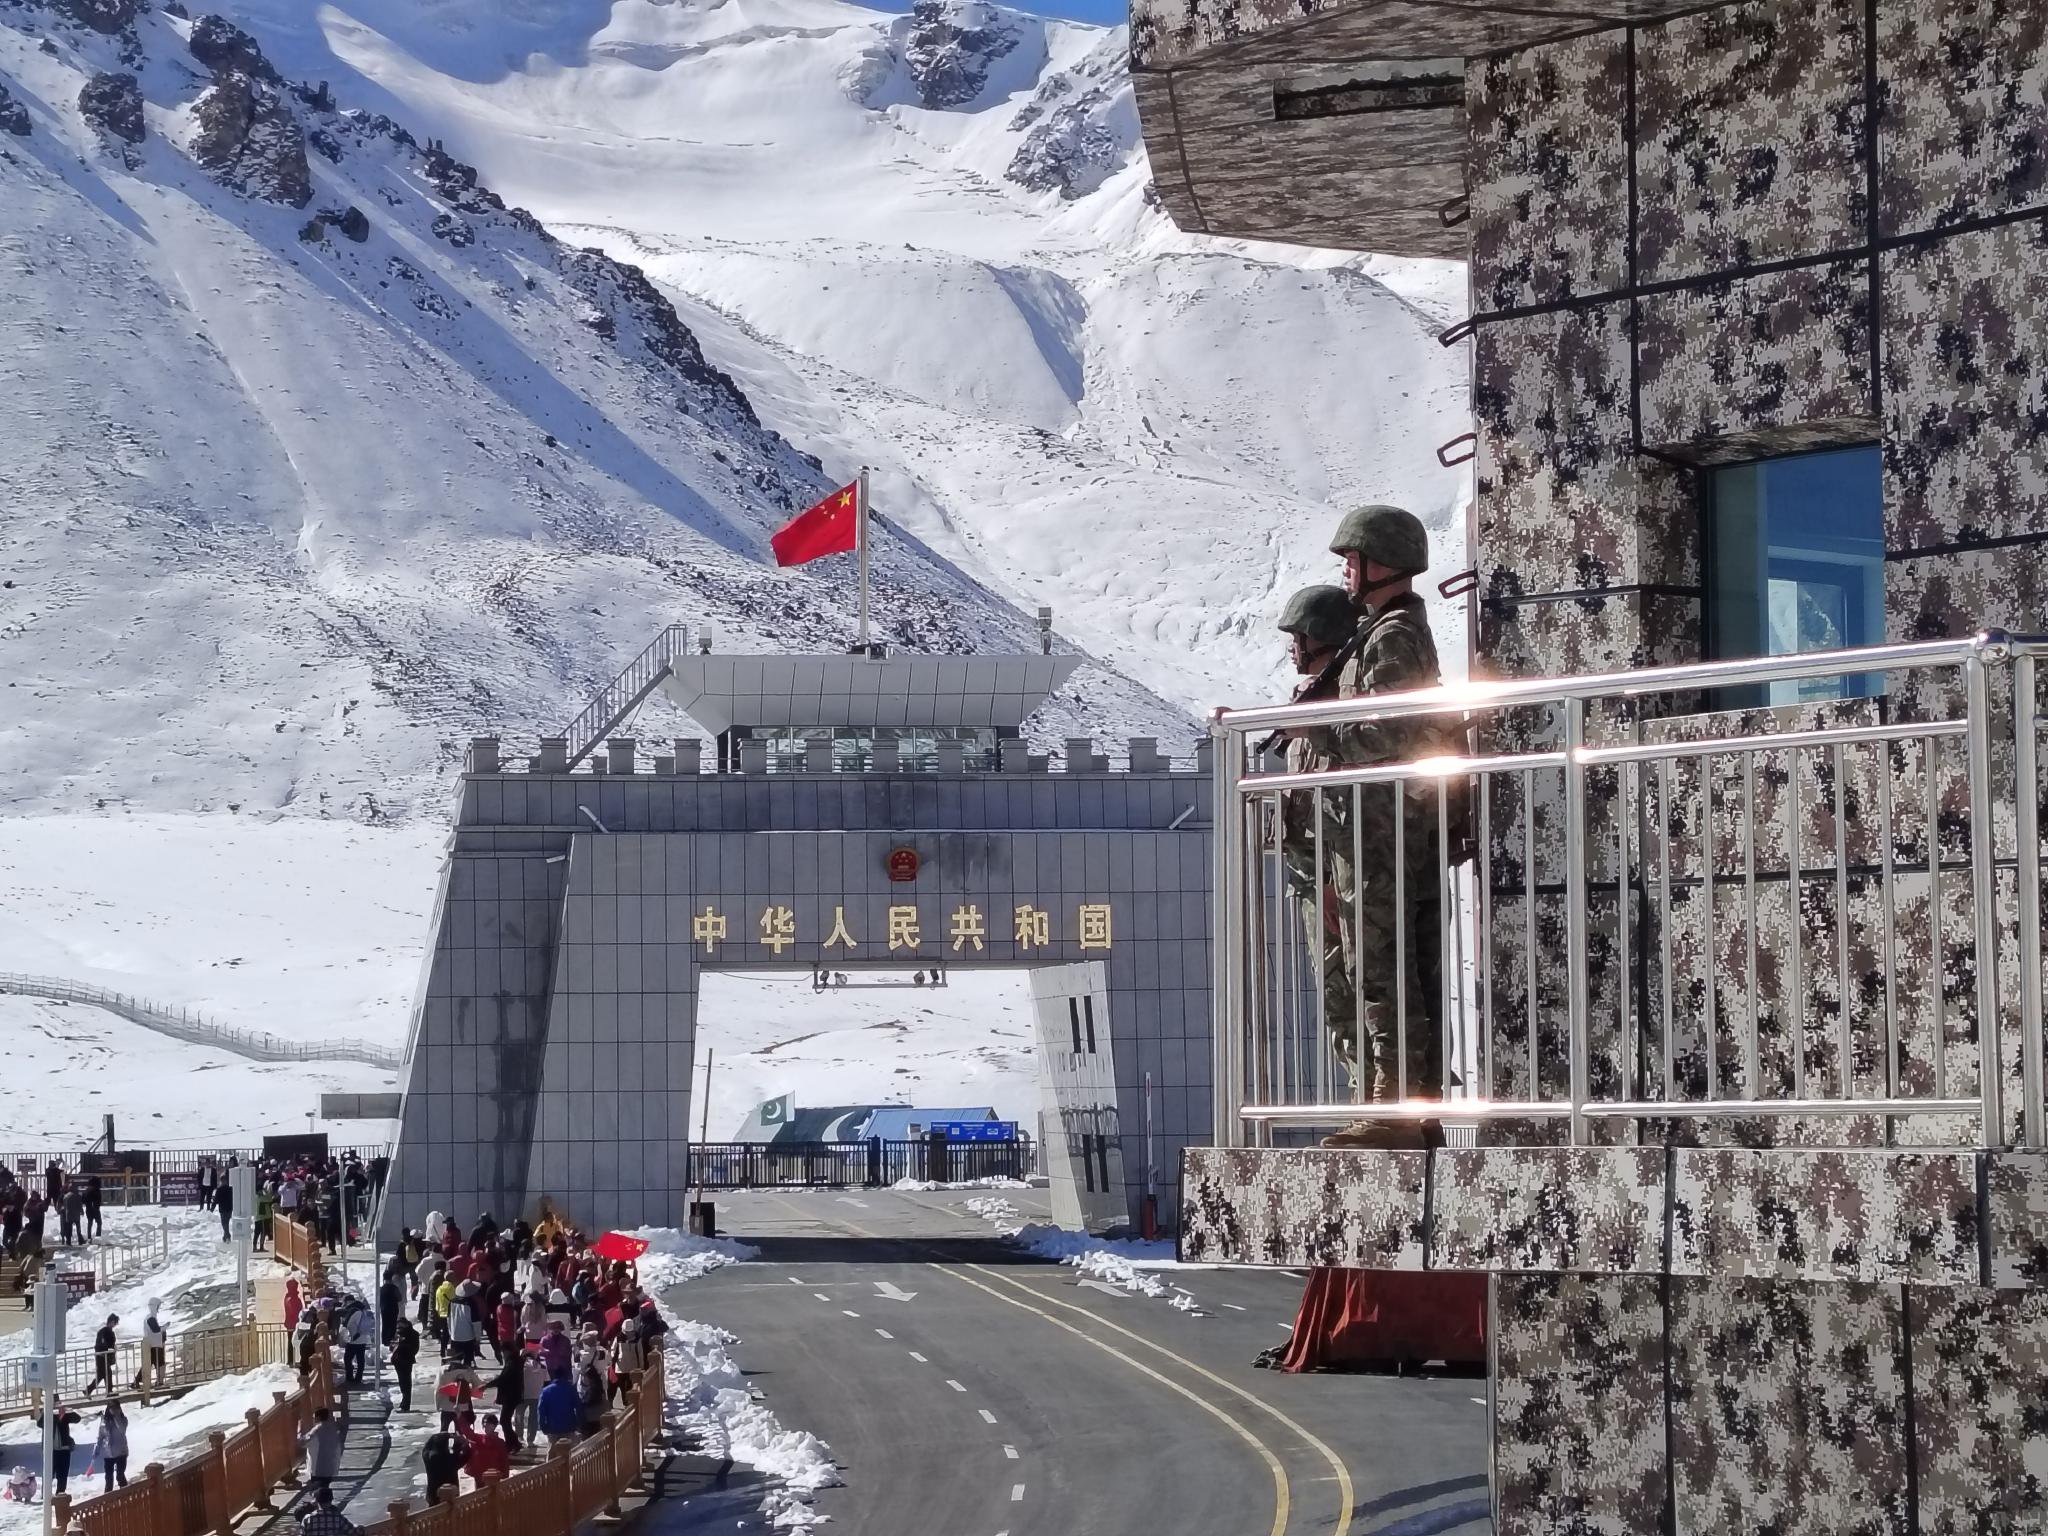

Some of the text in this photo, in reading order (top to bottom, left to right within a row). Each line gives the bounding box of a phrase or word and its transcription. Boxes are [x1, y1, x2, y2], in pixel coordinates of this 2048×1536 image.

[693, 904, 1112, 953] 中华人民共和国
